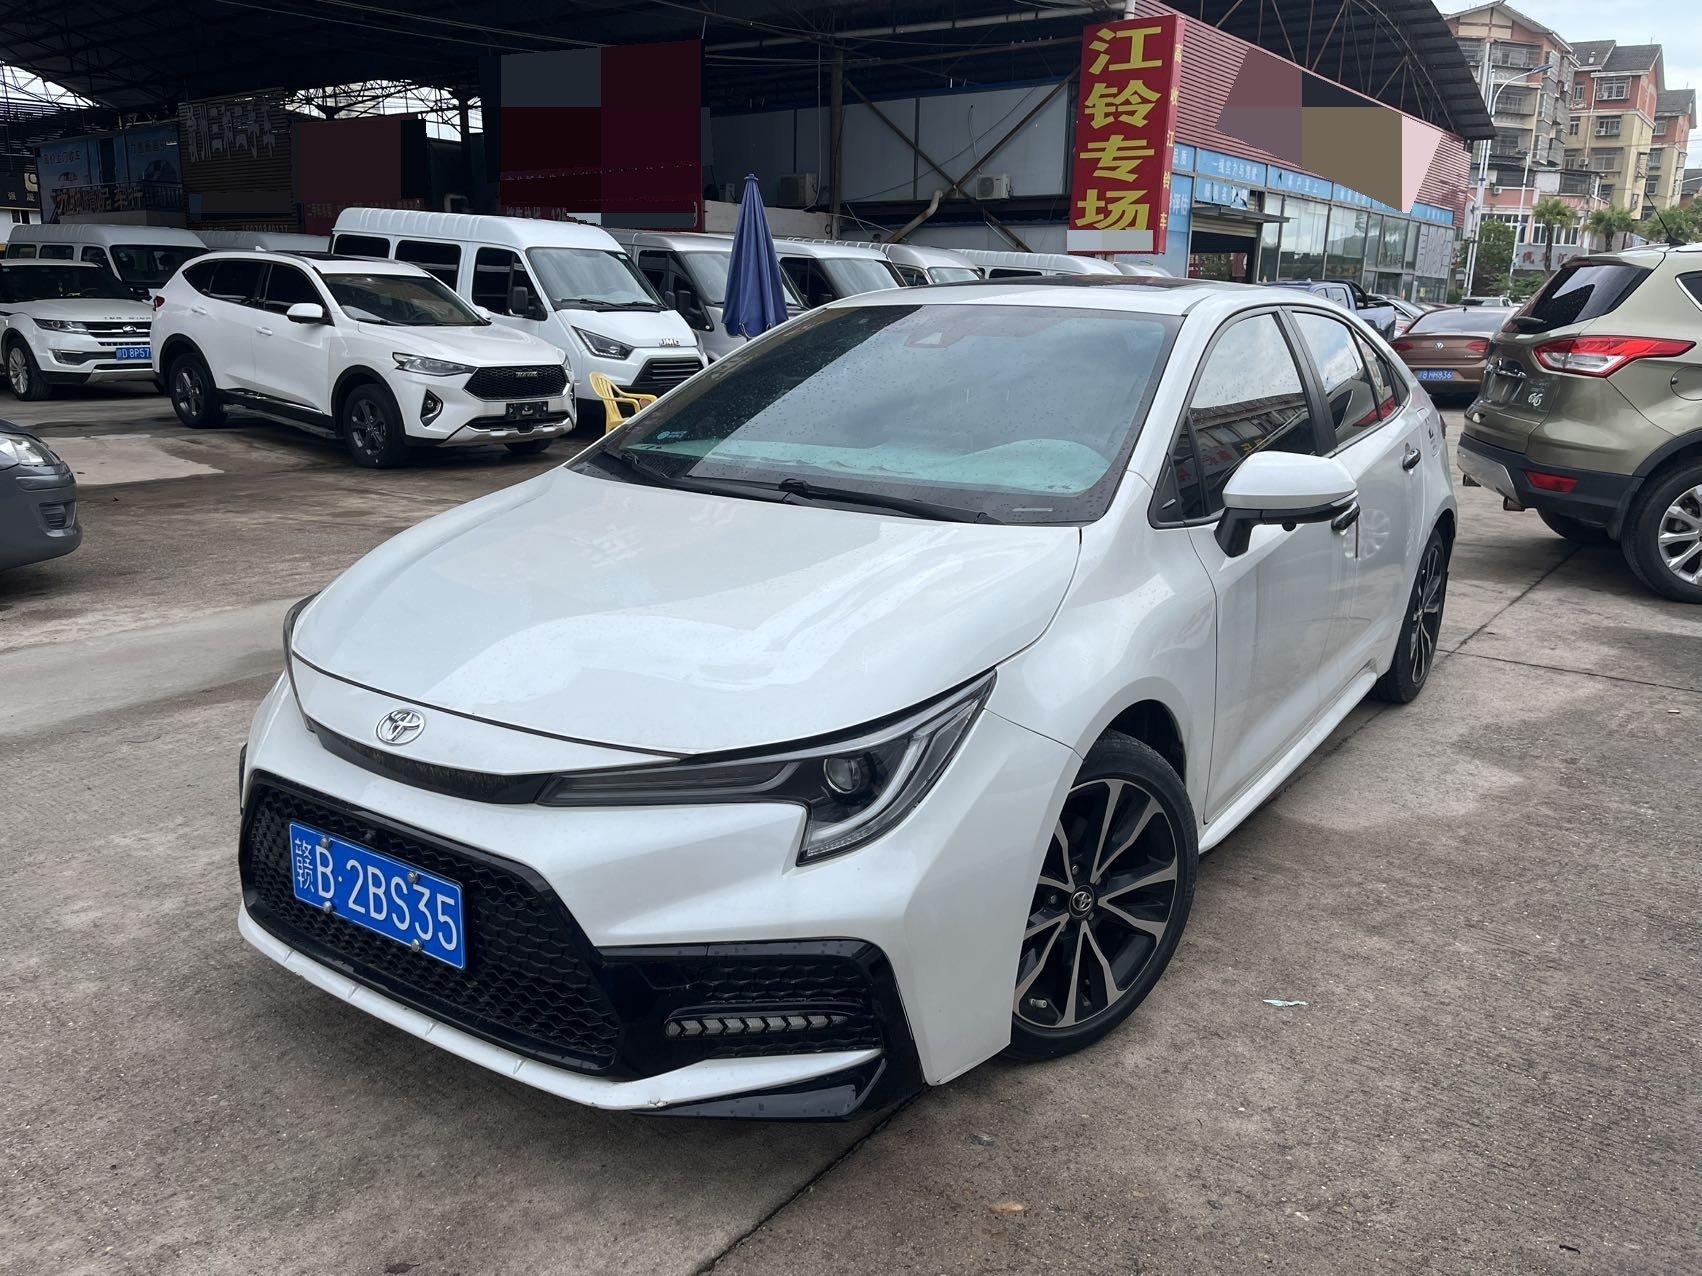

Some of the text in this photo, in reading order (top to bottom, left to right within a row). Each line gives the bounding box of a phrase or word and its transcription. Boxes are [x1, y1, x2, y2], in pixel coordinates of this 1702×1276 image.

[1075, 26, 1163, 231] 江铃专场
[294, 837, 458, 951] 赣B·2BS35
